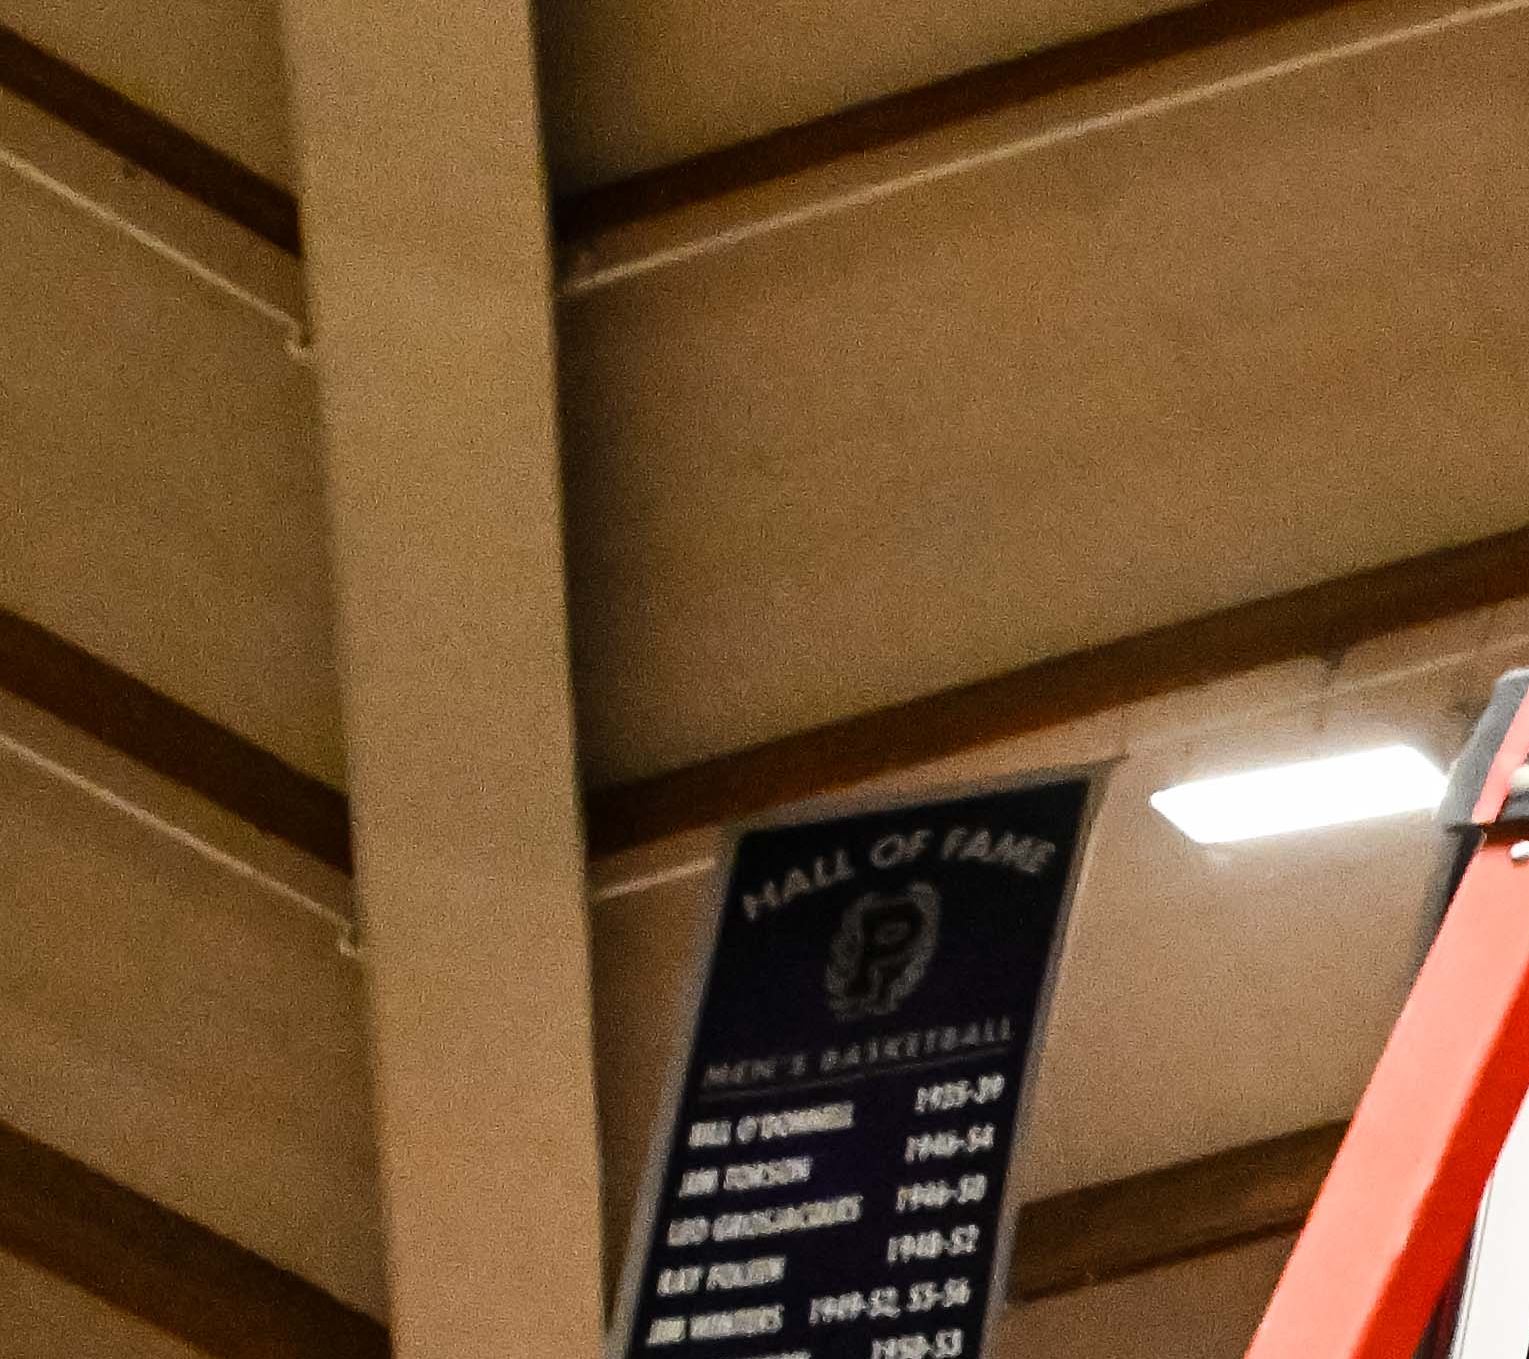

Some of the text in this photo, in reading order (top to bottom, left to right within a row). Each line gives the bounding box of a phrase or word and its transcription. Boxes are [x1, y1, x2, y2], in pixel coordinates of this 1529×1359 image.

[743, 827, 1056, 921] HALL OF FAME
